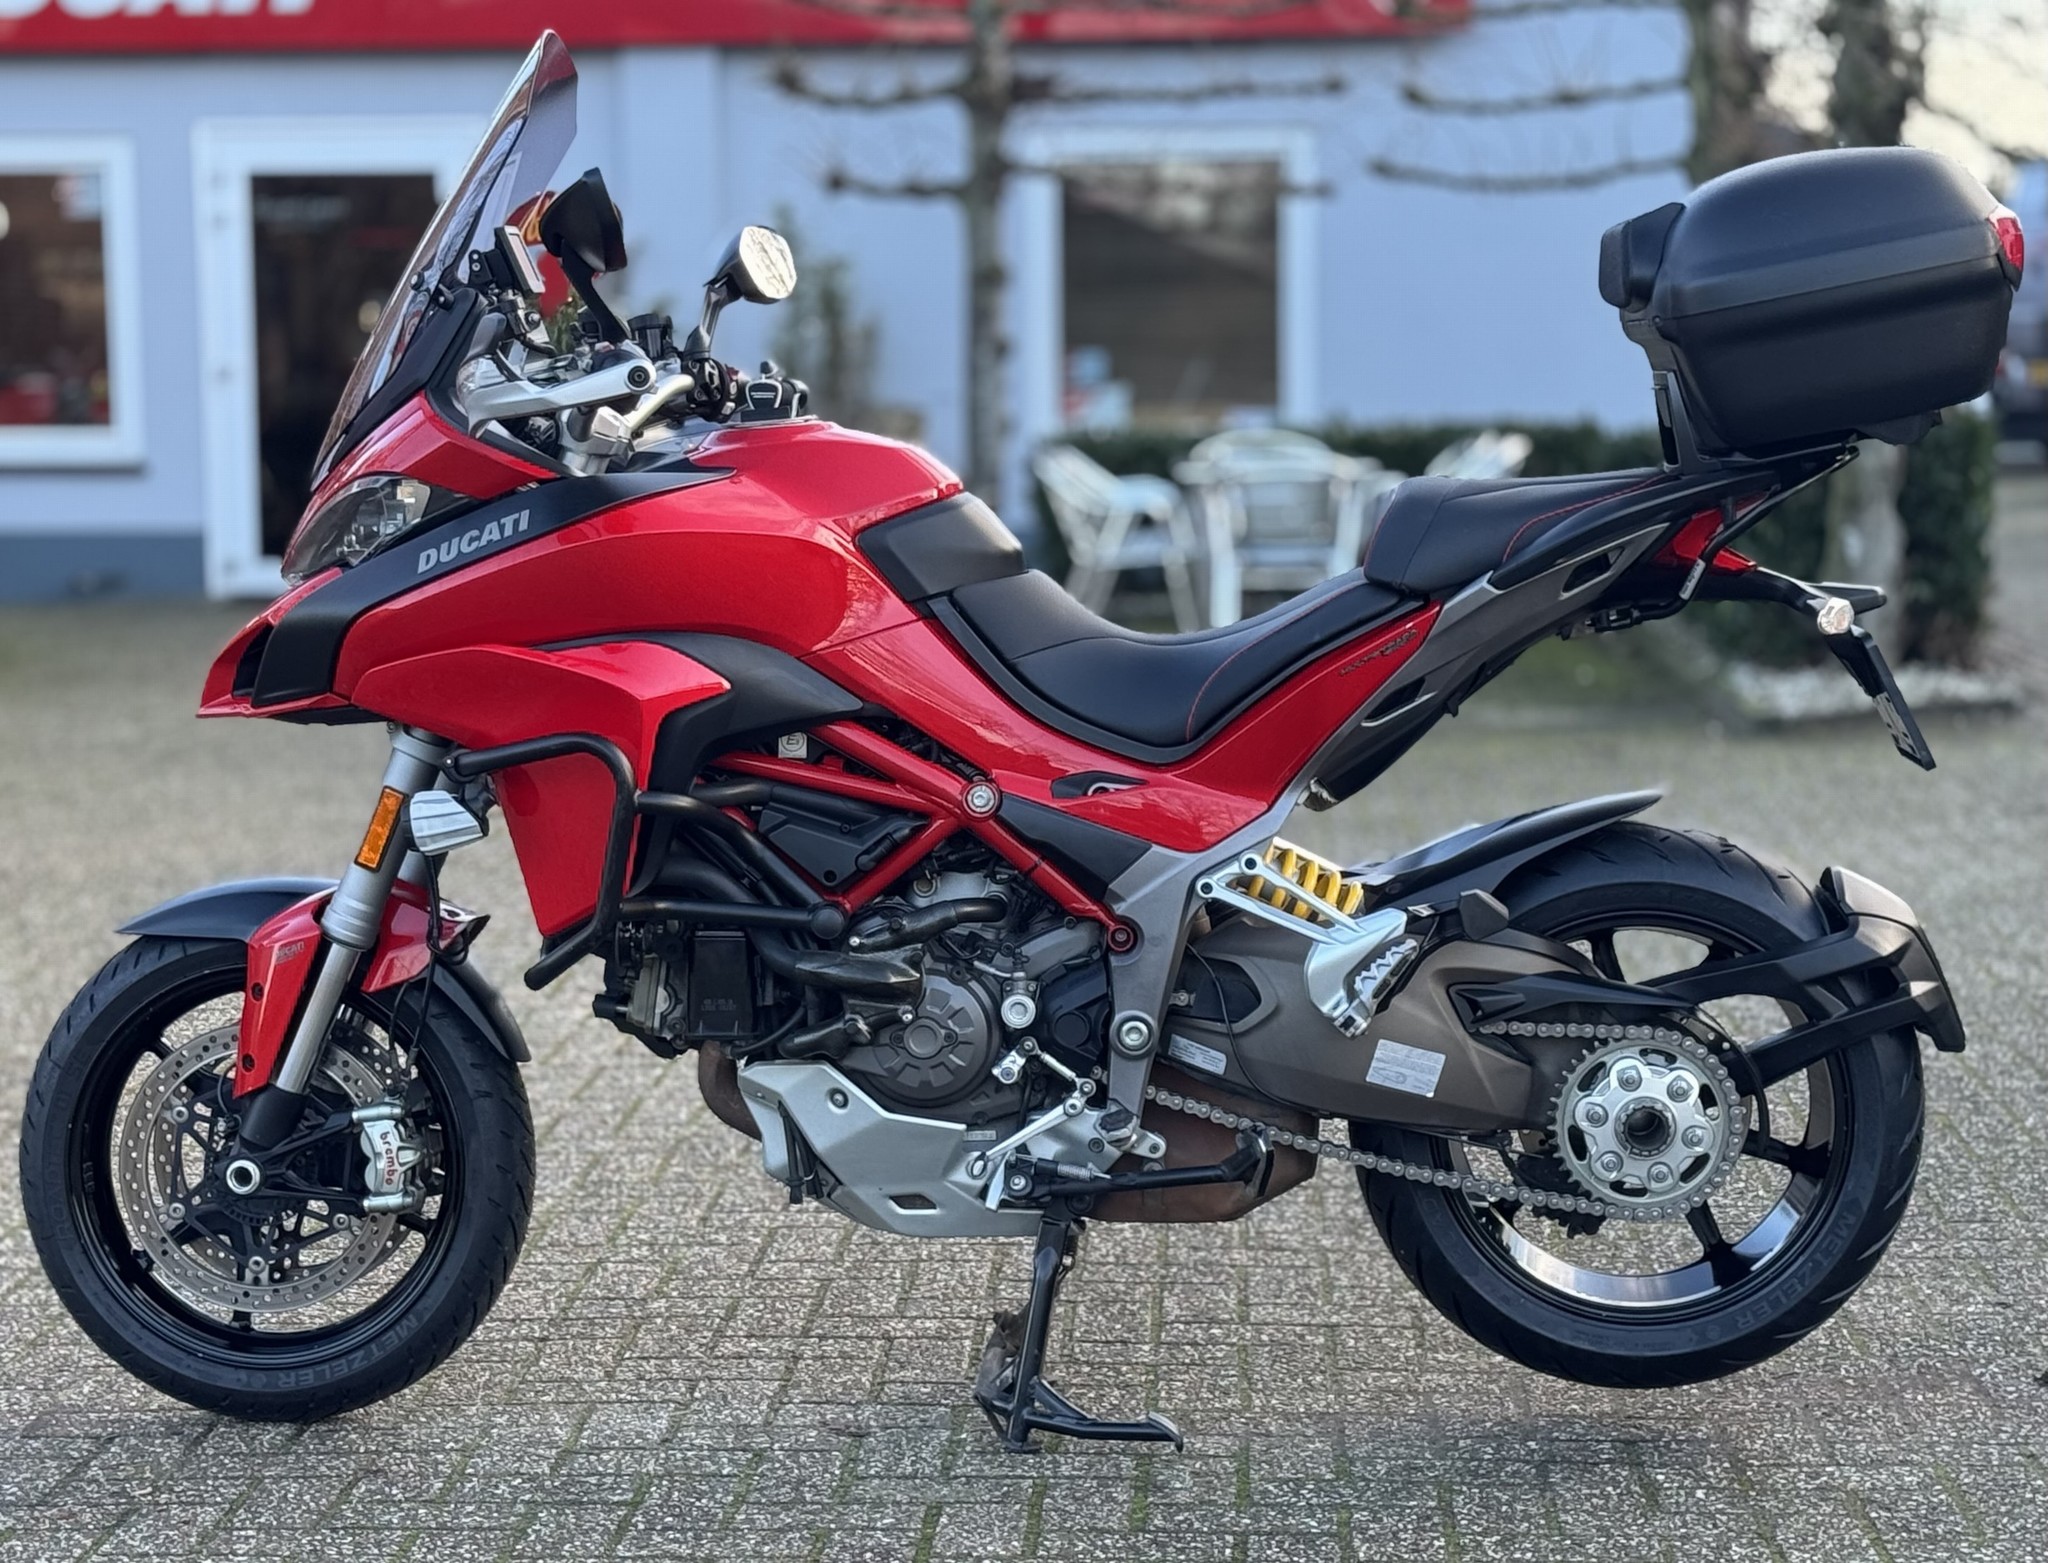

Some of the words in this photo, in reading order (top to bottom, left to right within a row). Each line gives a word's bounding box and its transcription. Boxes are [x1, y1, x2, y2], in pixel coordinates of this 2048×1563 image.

[417, 509, 530, 574] DUCATI
[380, 1131, 398, 1185] brembo
[1733, 1211, 1857, 1330] METZELER
[278, 1315, 419, 1388] METZELER
